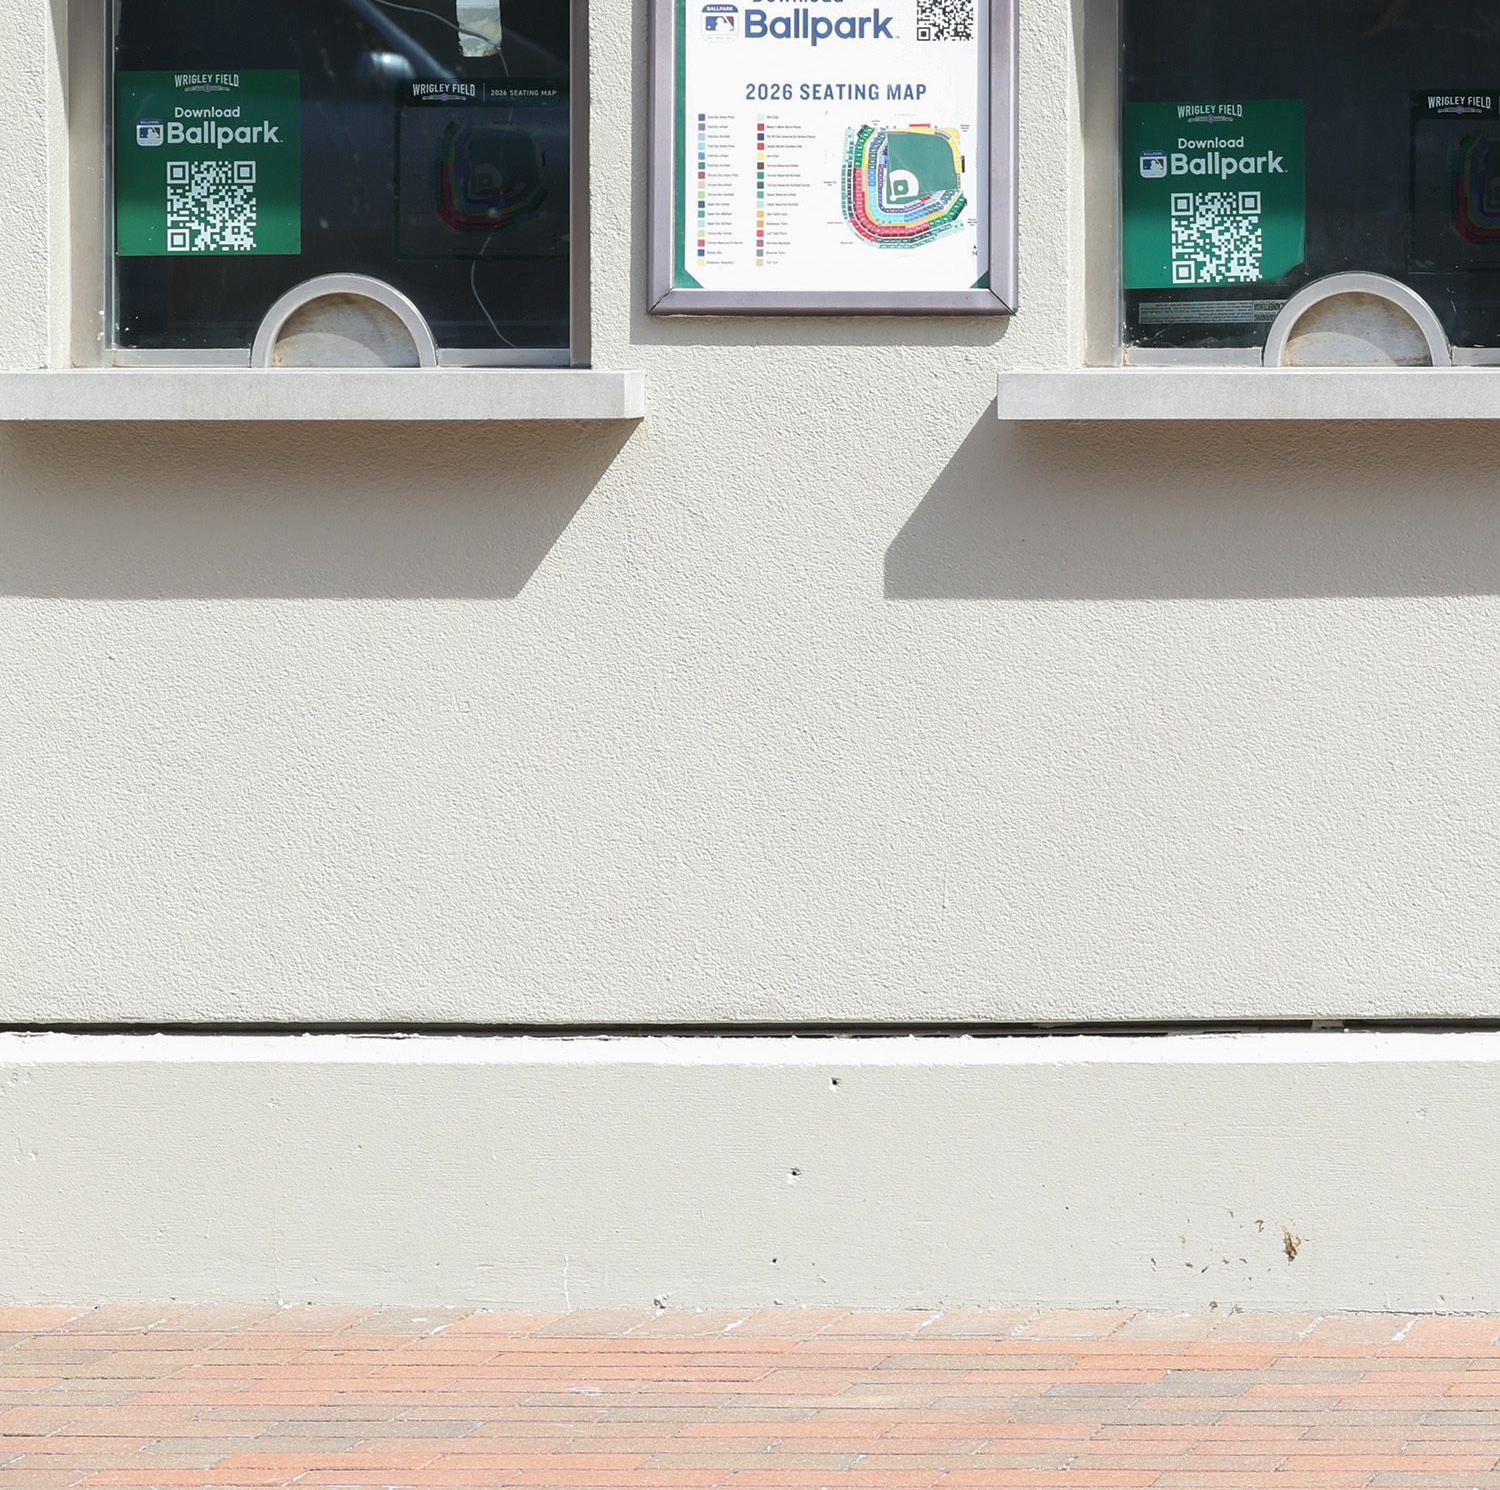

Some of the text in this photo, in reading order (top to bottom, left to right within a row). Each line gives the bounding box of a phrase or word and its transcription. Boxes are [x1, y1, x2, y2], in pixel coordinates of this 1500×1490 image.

[745, 8, 893, 46] Ballpark
[174, 74, 239, 87] WRIGLEY FIELD
[412, 83, 452, 97] WRIGLEY
[453, 83, 475, 97] FIELD
[746, 84, 926, 100] 2026 SEATING MAP
[1427, 96, 1466, 110] WRIGLEY
[1468, 96, 1491, 110] FIELD
[175, 106, 240, 117] Download
[1177, 104, 1242, 118] WRIGLEY FIELD
[168, 121, 279, 149] Ballpark
[1178, 136, 1244, 148] Download
[1171, 151, 1284, 179] Ballpark
